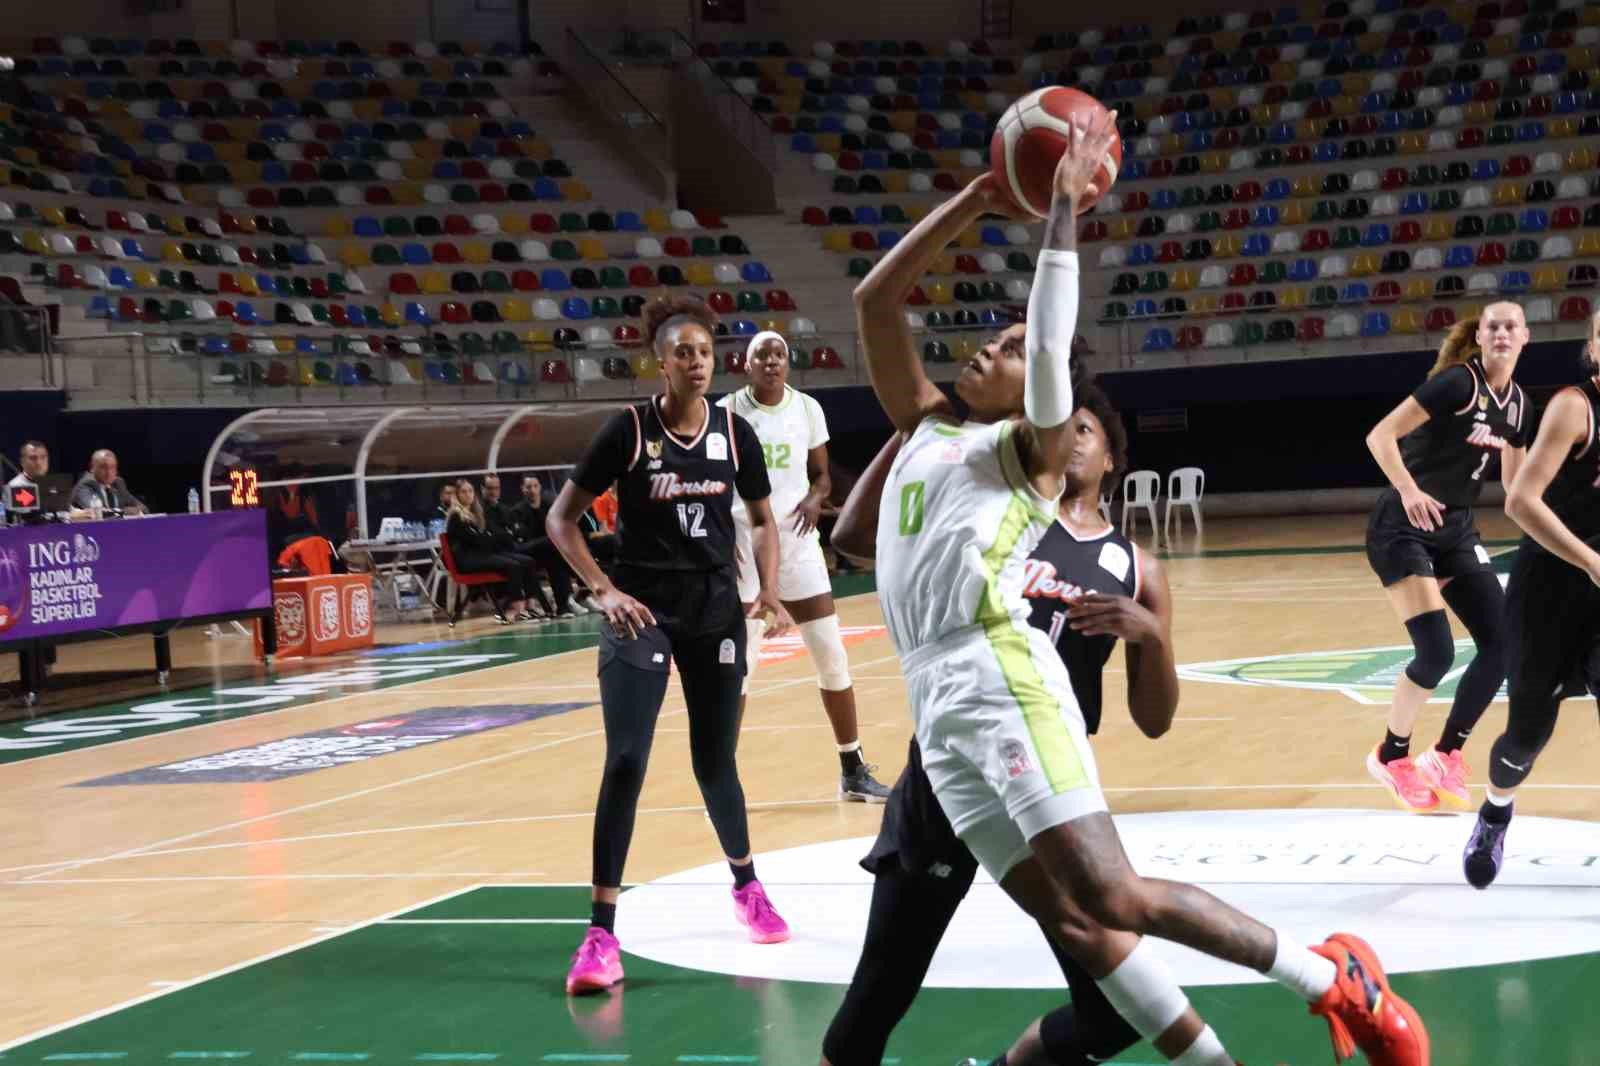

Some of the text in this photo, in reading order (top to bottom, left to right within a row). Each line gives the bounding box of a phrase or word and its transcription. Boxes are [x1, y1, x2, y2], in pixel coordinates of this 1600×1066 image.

[229, 469, 259, 506] 22
[649, 472, 727, 500] Mersin
[676, 502, 708, 538] 12
[898, 480, 926, 537] 0
[28, 540, 71, 568] ING
[29, 567, 93, 589] KADINLAR
[31, 583, 104, 606] BASKETBOL
